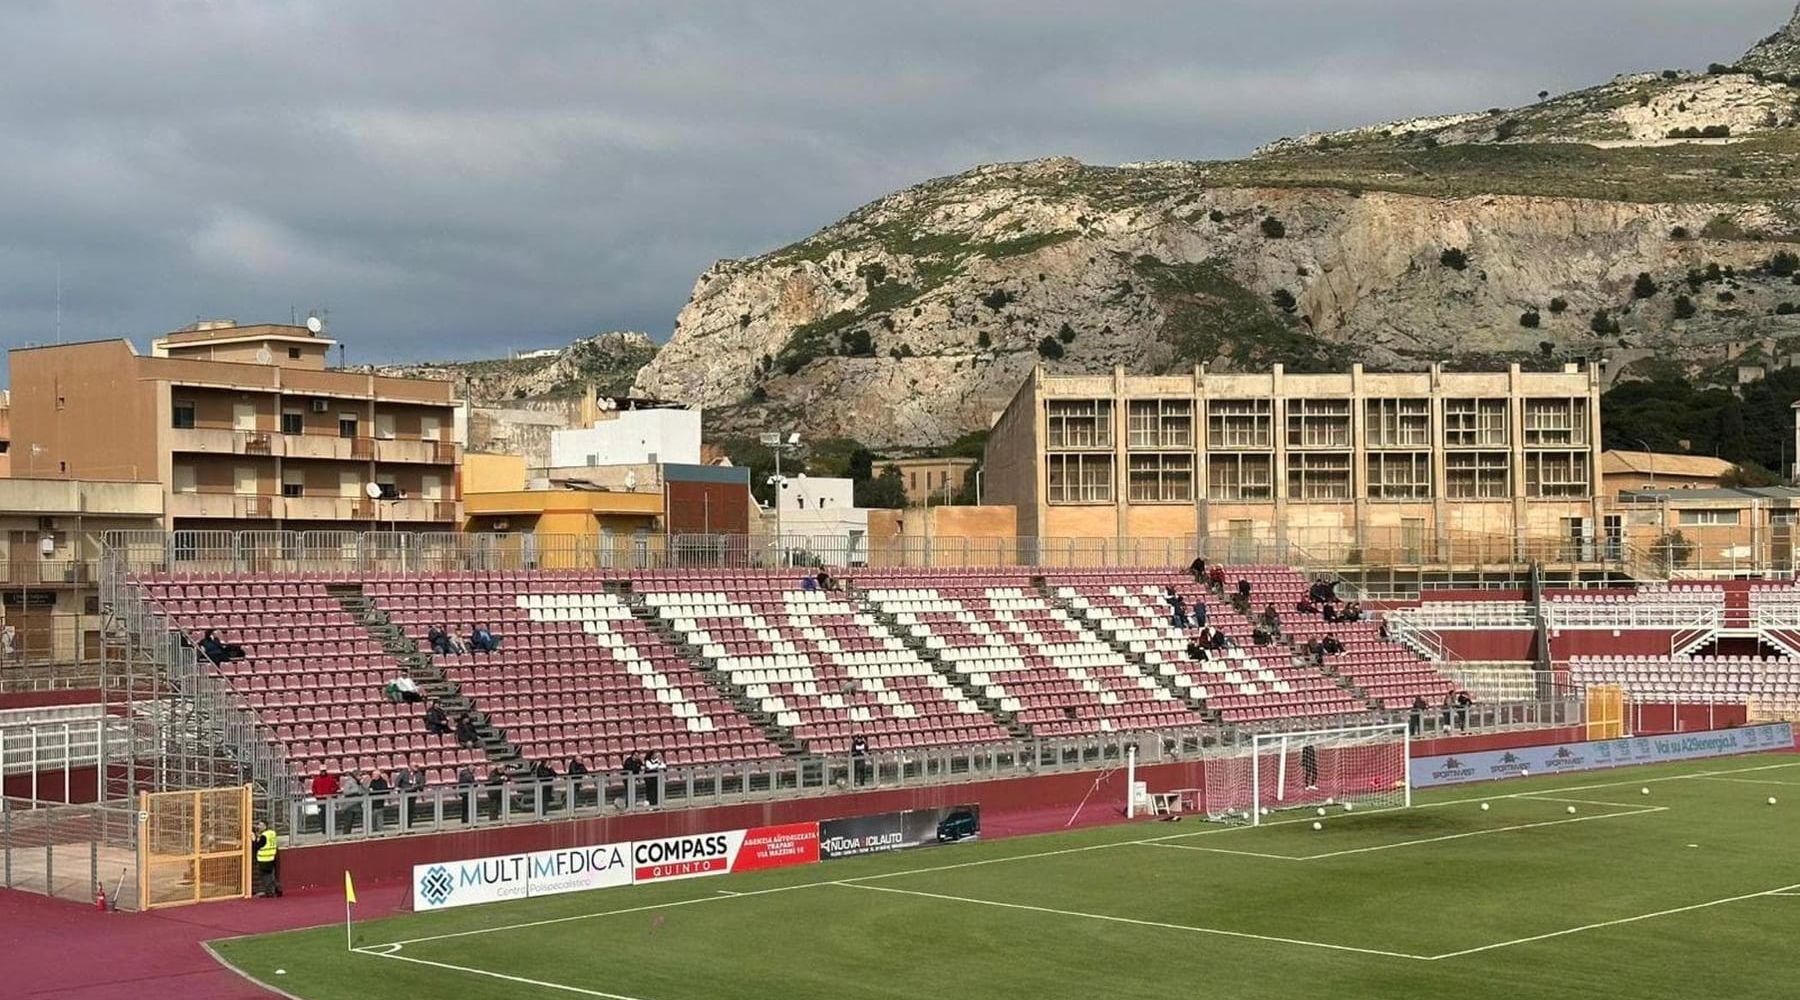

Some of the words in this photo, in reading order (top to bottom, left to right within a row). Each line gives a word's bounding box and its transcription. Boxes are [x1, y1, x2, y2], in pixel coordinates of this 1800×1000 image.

[635, 836, 727, 864] COMPASS
[831, 837, 860, 851] NUOVA
[861, 833, 903, 847] ICILAUTO
[653, 861, 711, 876] QUINTO
[496, 886, 526, 897] Centro
